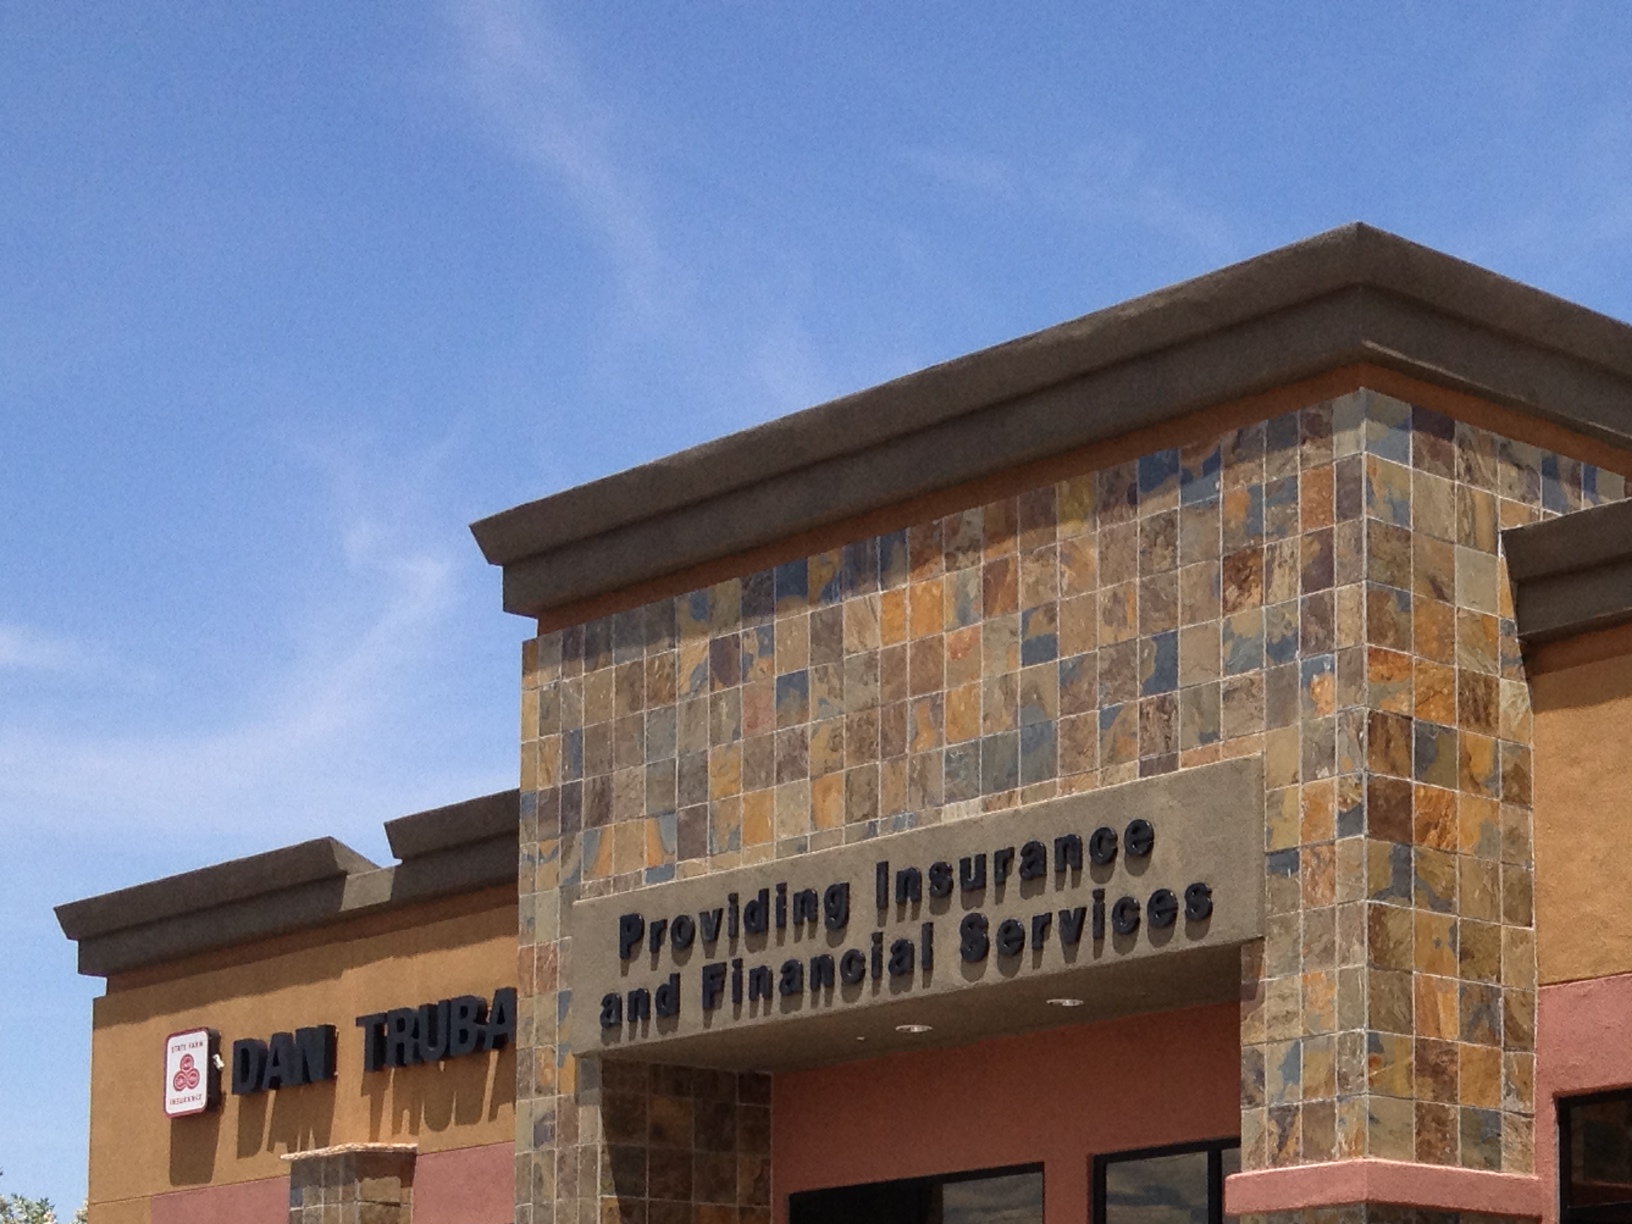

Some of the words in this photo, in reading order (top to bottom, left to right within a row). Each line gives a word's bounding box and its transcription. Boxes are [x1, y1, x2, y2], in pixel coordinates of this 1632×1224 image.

[600, 972, 681, 1028] and
[702, 921, 934, 1010] Financial
[960, 882, 1214, 963] Services
[619, 882, 850, 960] Providing
[875, 819, 1155, 910] Insurance
[231, 1024, 339, 1095] DAN
